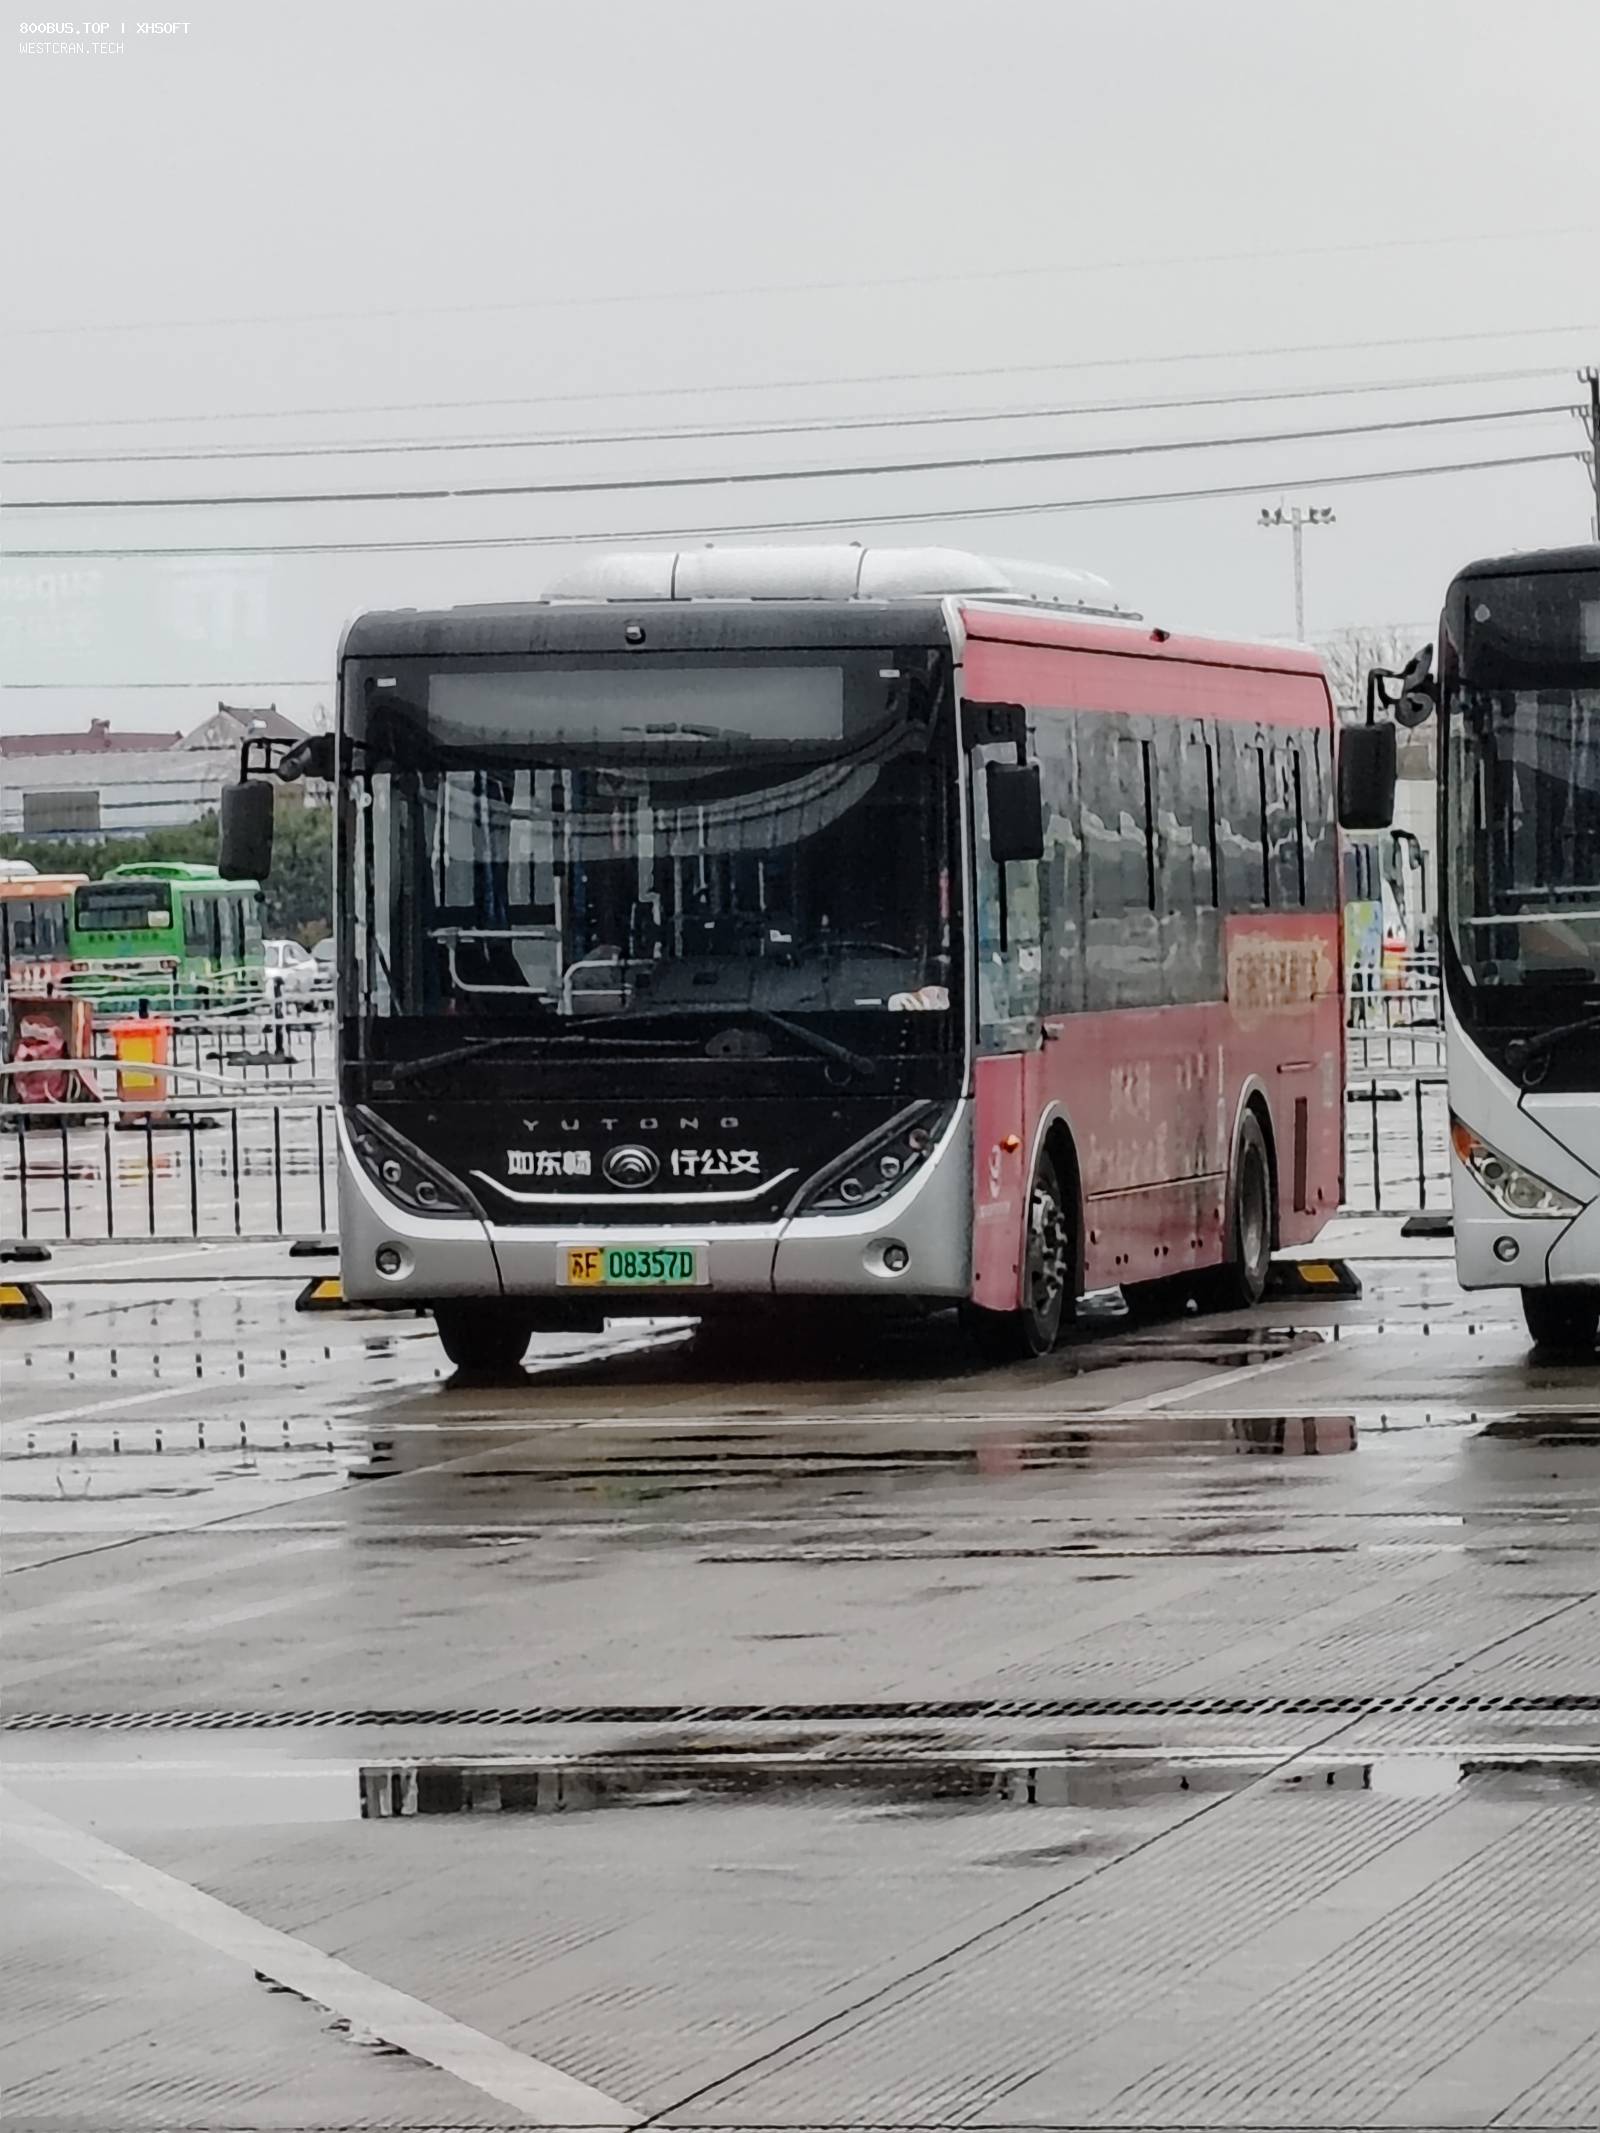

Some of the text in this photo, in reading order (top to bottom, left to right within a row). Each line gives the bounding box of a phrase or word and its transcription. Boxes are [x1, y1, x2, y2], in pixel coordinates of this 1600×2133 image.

[522, 1117, 739, 1131] YUTONG
[670, 1149, 761, 1176] 行公交
